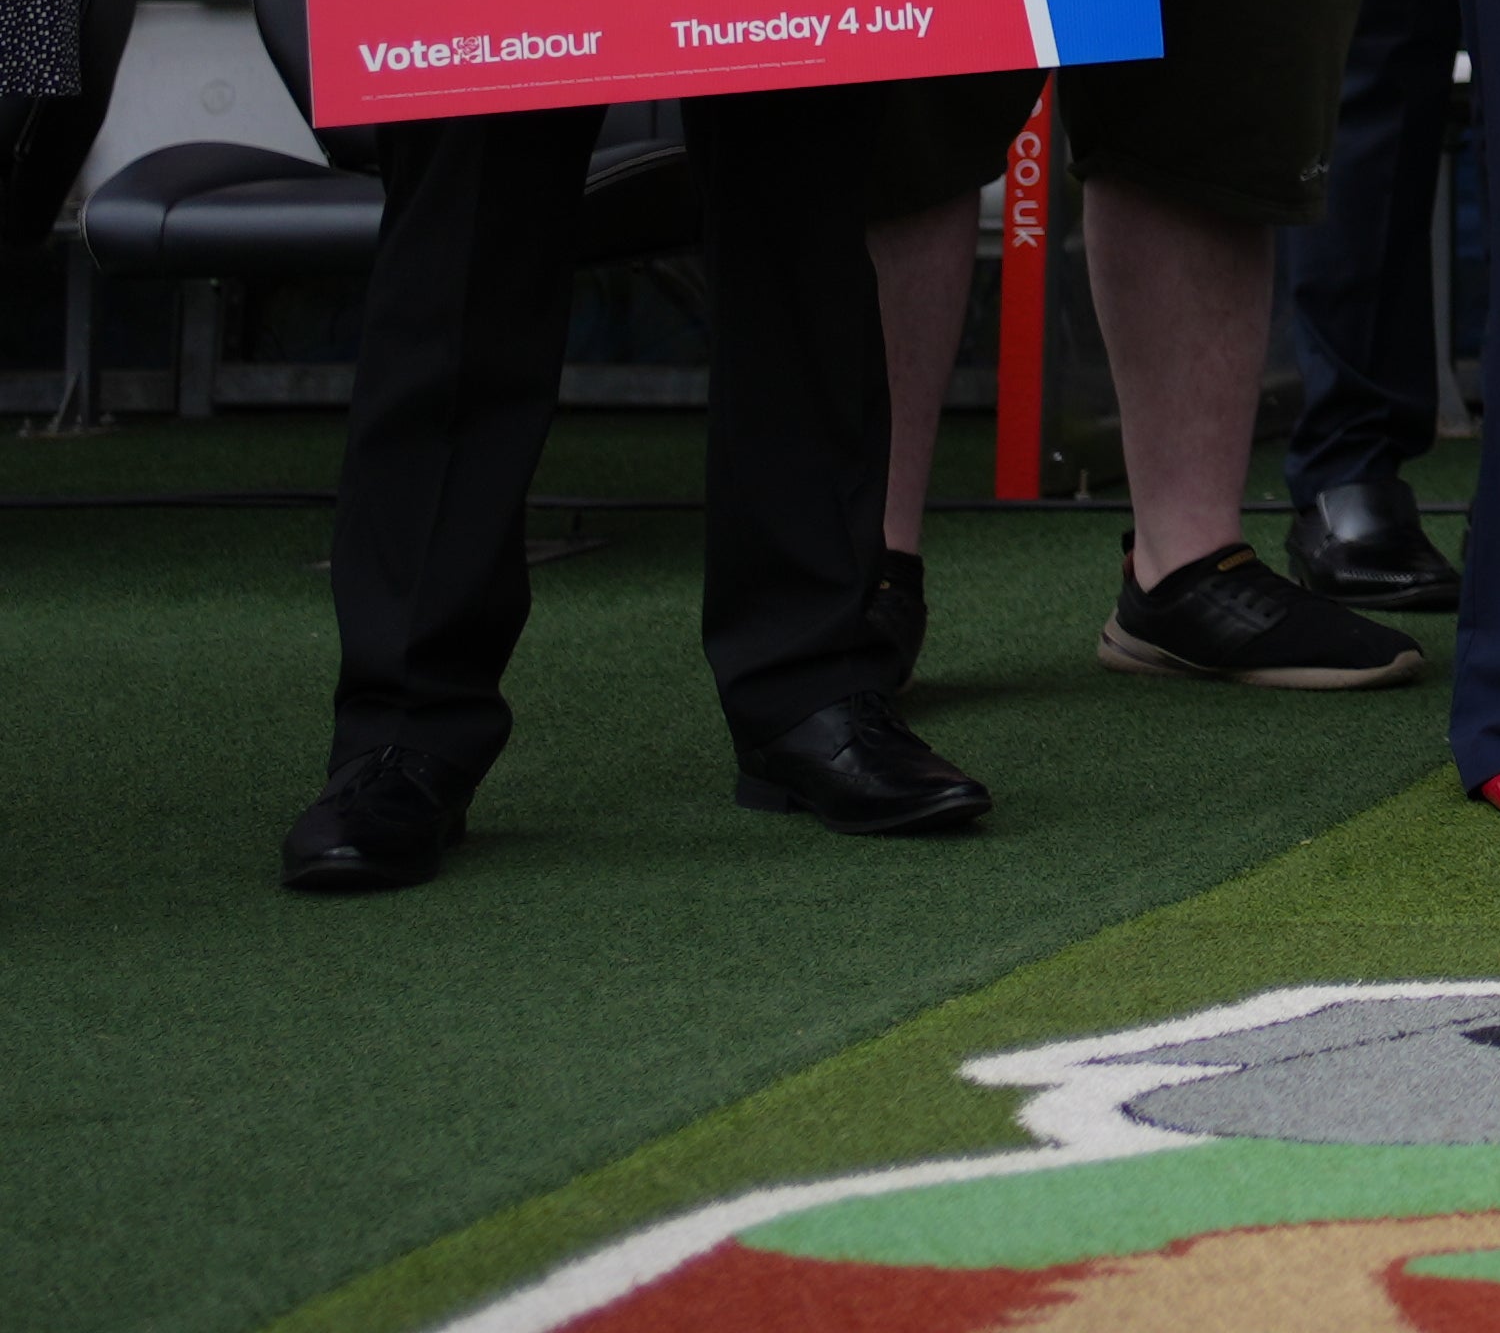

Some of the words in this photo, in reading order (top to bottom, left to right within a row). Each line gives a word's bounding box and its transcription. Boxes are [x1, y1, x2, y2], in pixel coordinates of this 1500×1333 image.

[359, 40, 451, 73] Vote
[484, 31, 603, 63] Labour
[671, 13, 831, 48] Thursday
[837, 9, 860, 35] 4
[865, 2, 934, 38] July
